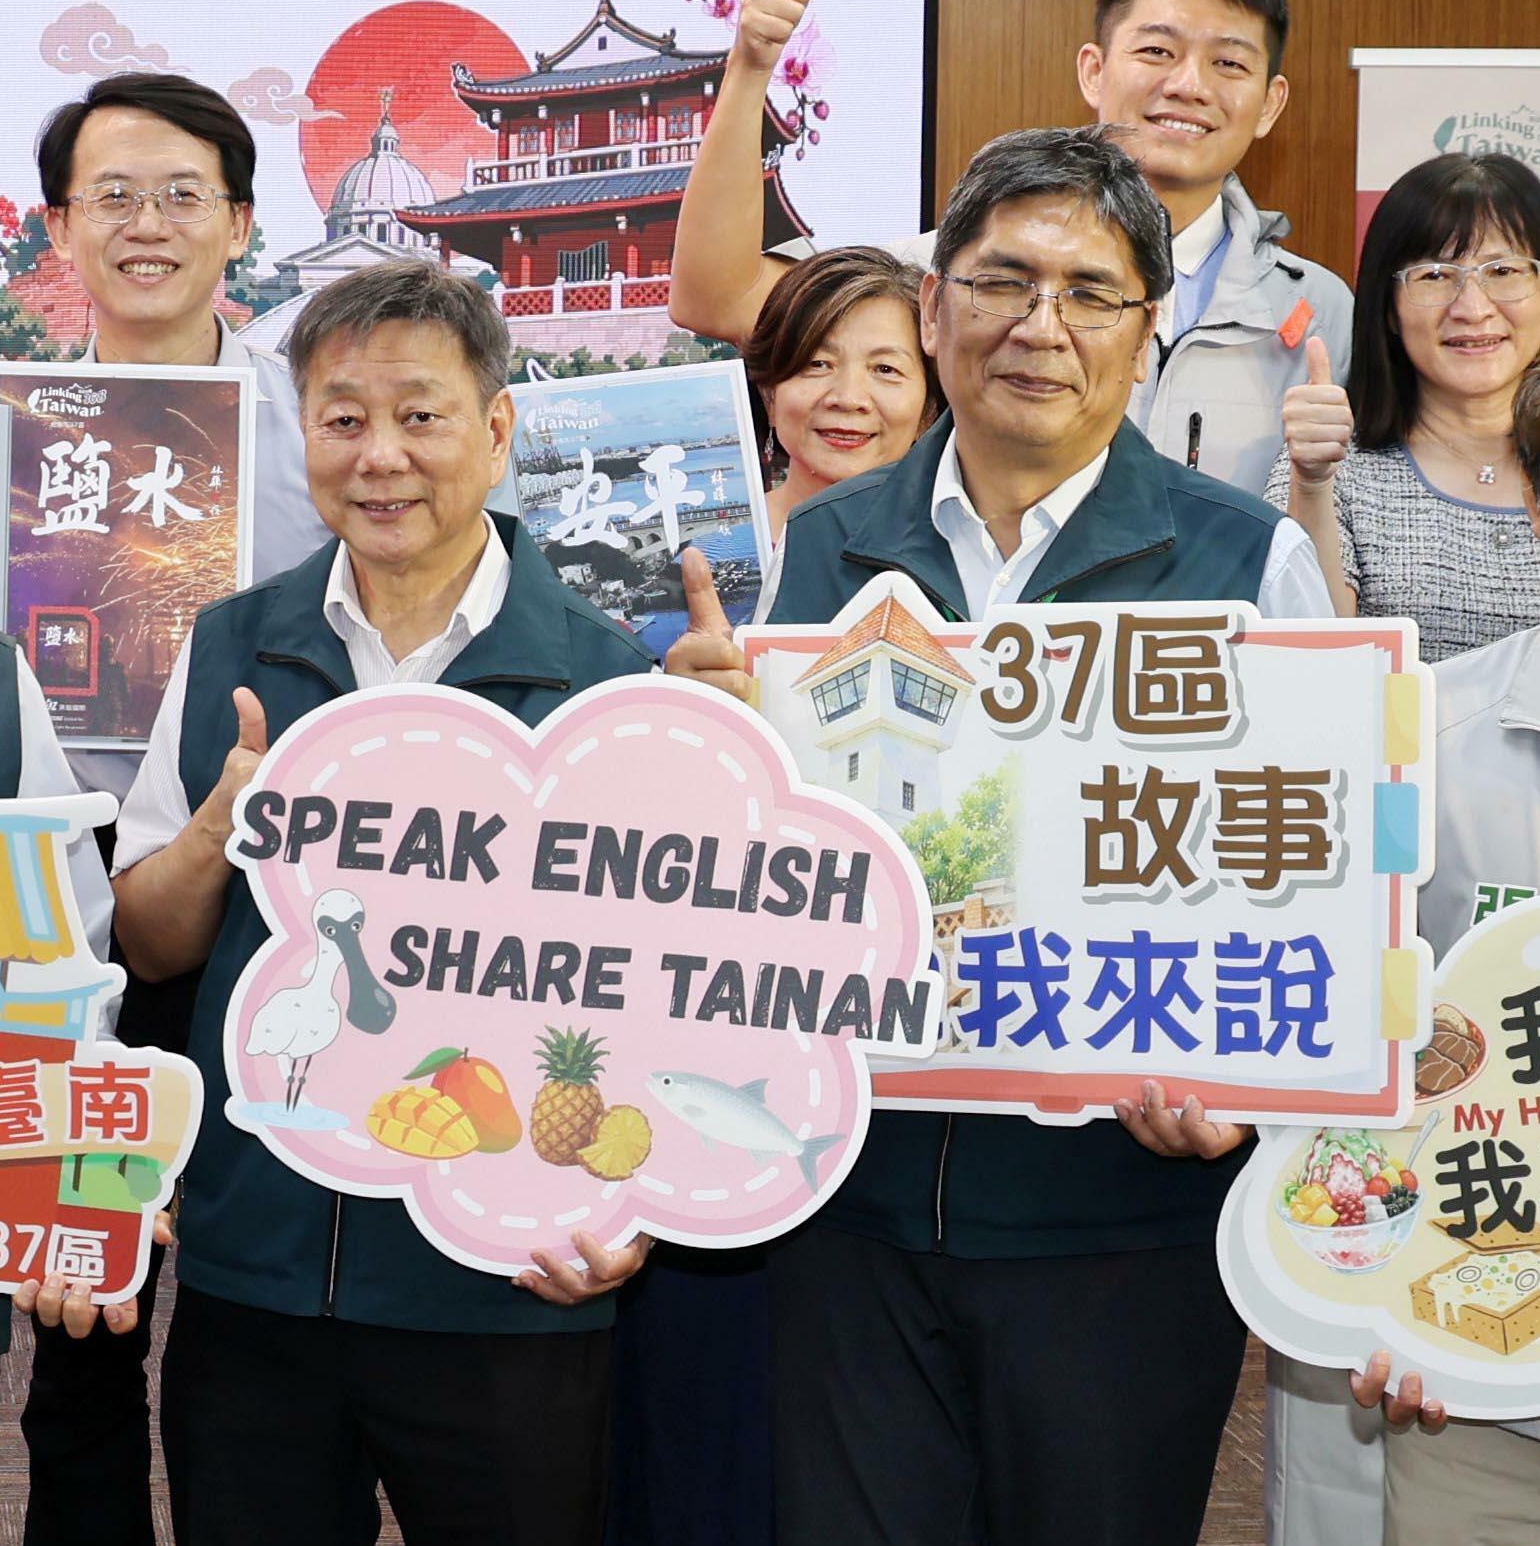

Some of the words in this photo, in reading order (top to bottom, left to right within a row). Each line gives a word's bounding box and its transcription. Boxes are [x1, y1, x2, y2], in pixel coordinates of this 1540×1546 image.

[1461, 113, 1535, 143] Linking
[40, 399, 103, 417] Taiwan
[42, 387, 83, 403] Linking
[536, 417, 600, 432] Taiwan
[31, 432, 206, 536] 鹽水
[546, 445, 706, 555] 安平
[979, 611, 1233, 735] 37區
[237, 789, 508, 886] SPEAK
[531, 820, 872, 925] ENGLISH
[1080, 765, 1333, 890] 故事
[384, 923, 633, 1011] SHARE
[660, 952, 931, 1046] TAINAN
[928, 927, 1336, 1057] 我來說
[1452, 1101, 1507, 1138] My
